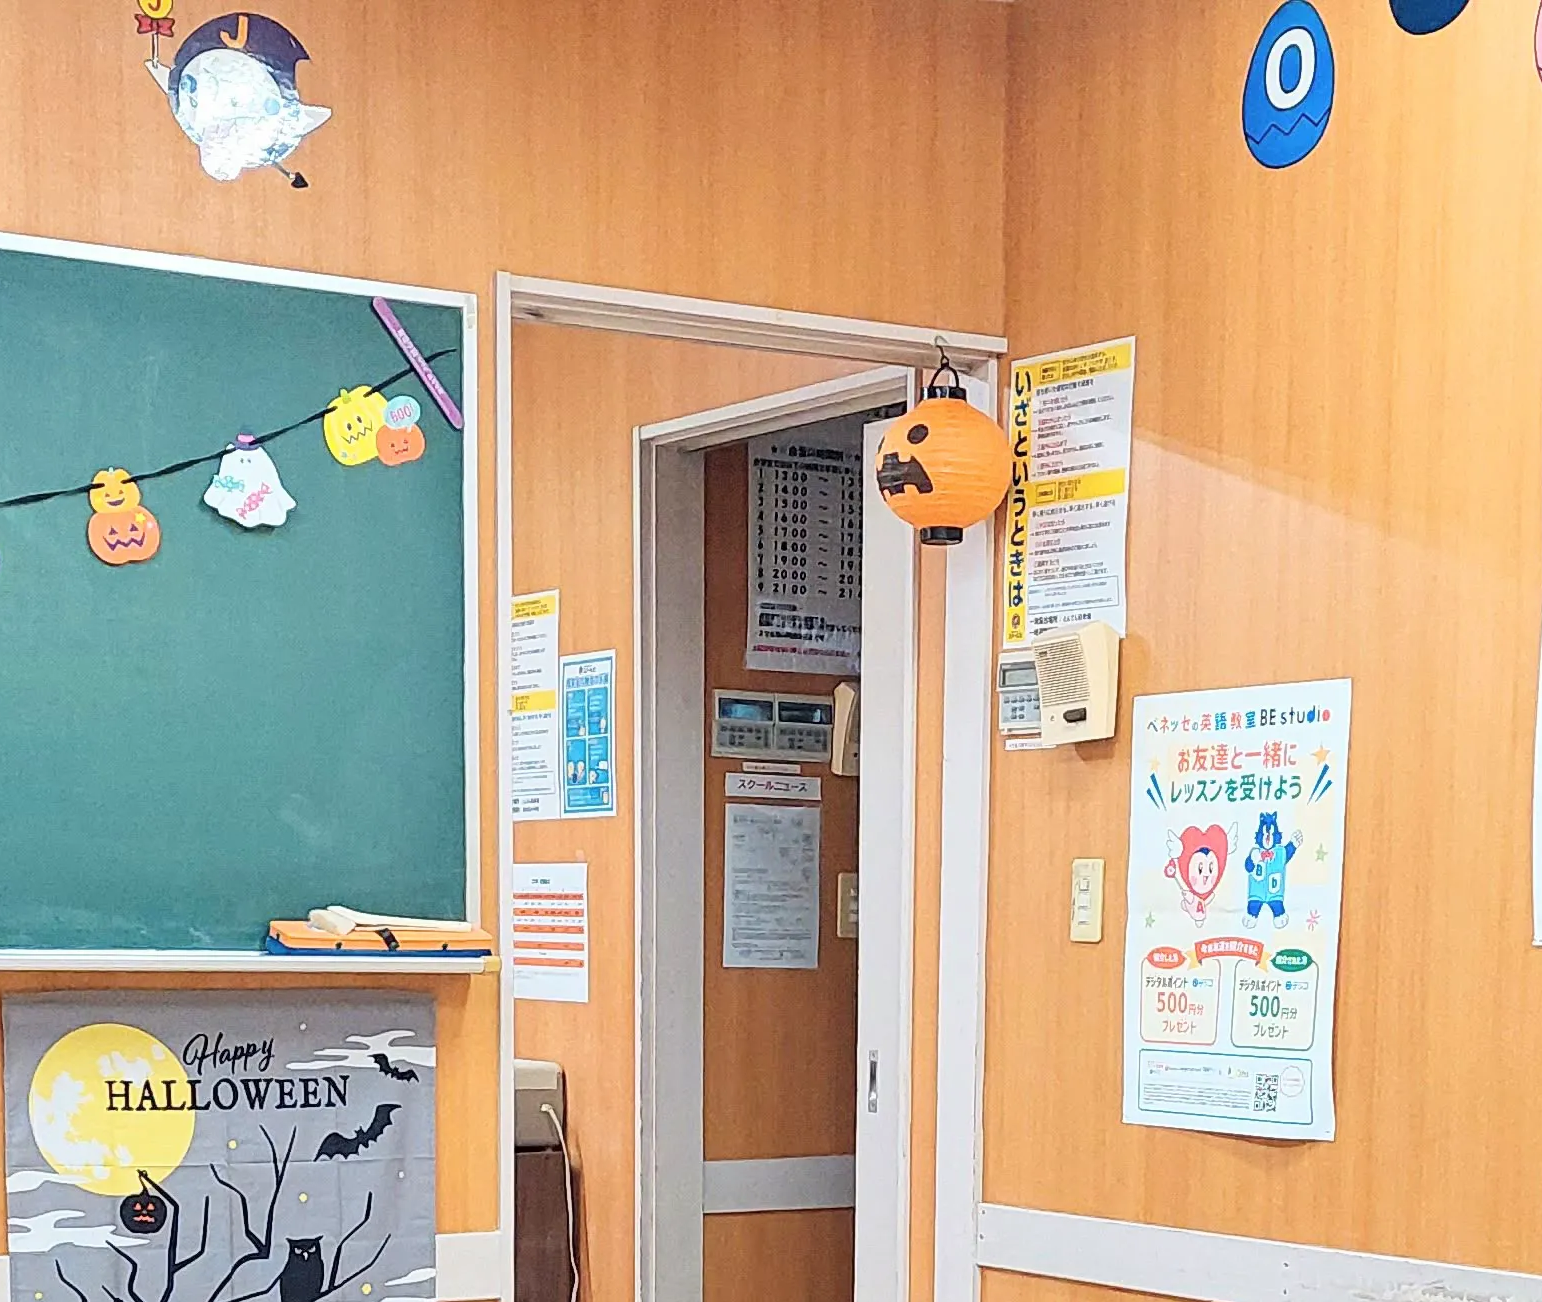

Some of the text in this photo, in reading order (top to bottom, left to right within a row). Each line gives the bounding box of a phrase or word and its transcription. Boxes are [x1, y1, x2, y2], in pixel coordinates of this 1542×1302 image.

[220, 15, 248, 49] J
[1008, 369, 1032, 608] いざというときは
[1280, 705, 1331, 725] studio
[1177, 740, 1297, 773] お友達と一緒に
[737, 779, 808, 793] スクールニュース
[1170, 774, 1302, 804] レッスンを受けよう
[182, 1032, 275, 1075] Happy
[105, 1075, 351, 1111] HALLOWEEN
